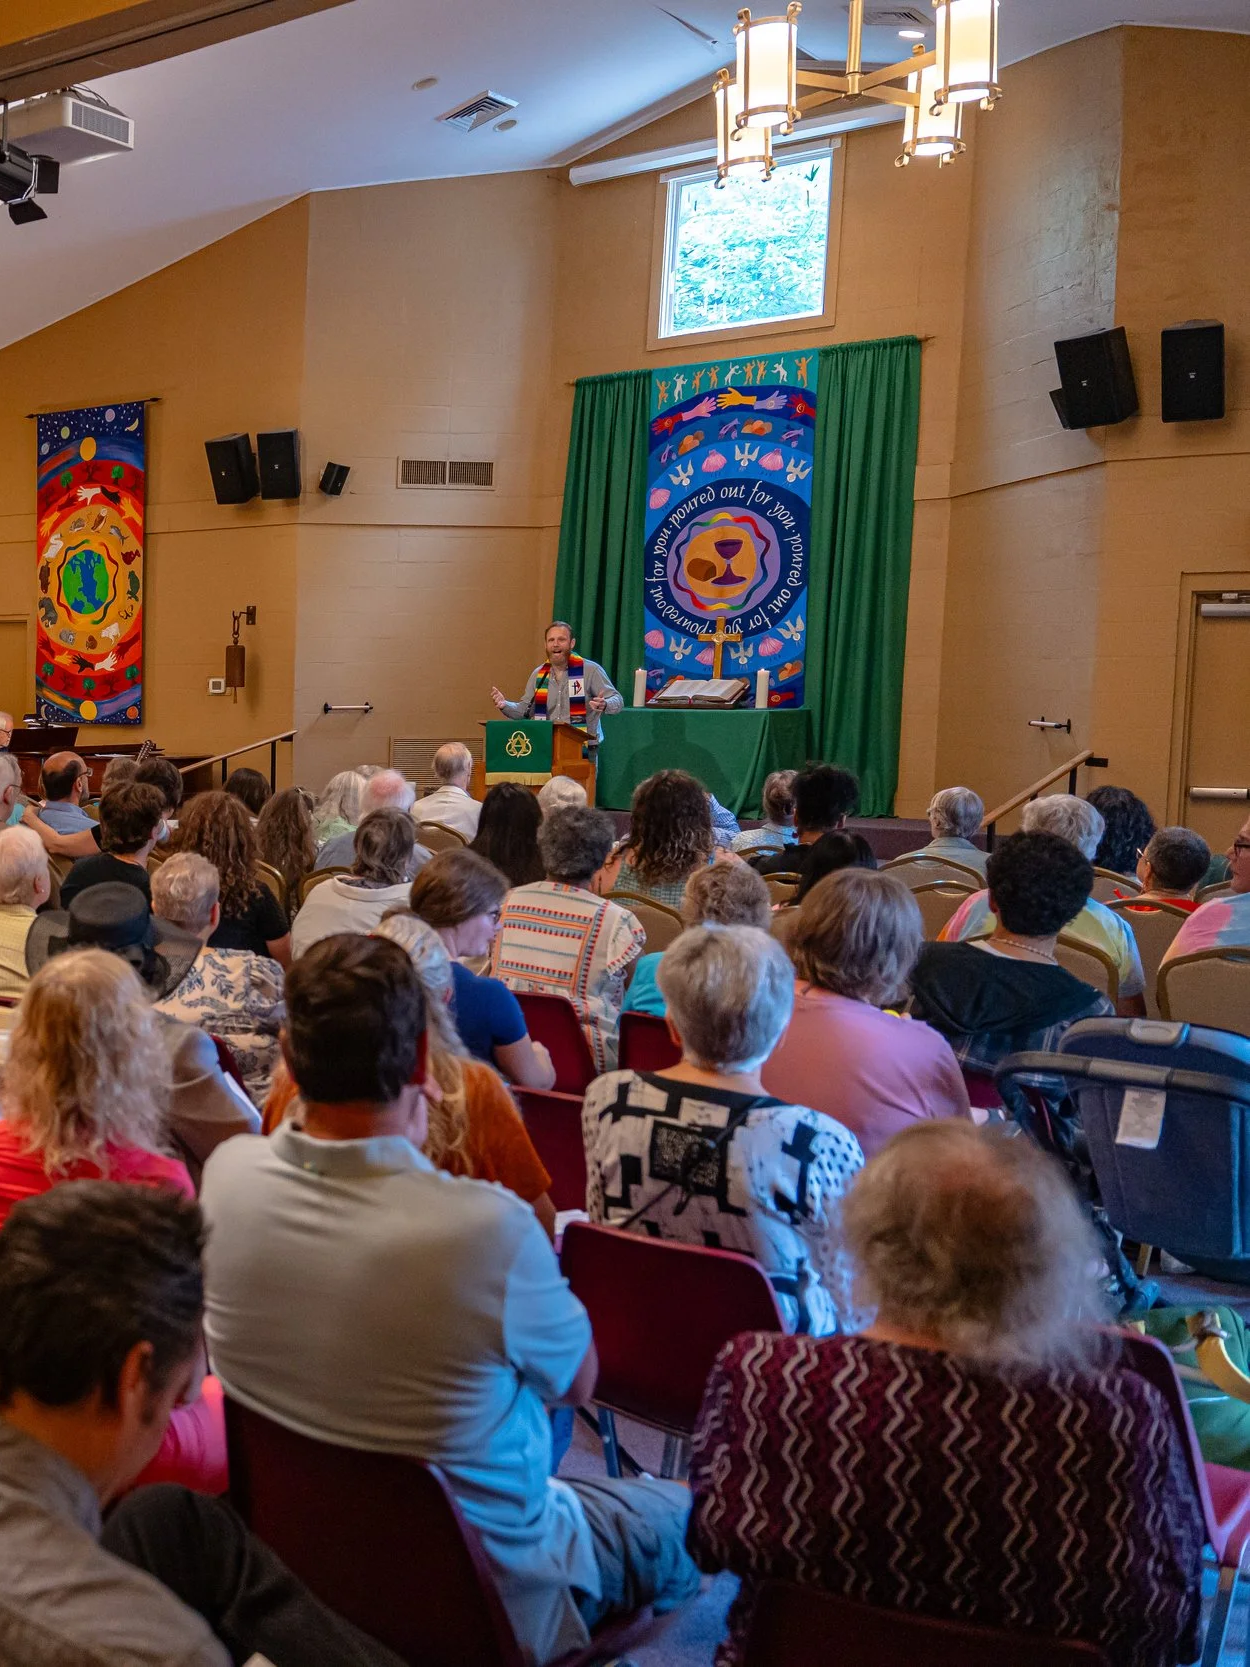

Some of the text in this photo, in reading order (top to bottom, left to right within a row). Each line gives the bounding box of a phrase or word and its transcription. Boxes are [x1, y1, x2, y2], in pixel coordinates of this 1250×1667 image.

[668, 480, 797, 531] poured out for you
[645, 526, 711, 635] poured out for you
[783, 533, 805, 587] poured
[748, 607, 773, 630] for
[768, 588, 792, 614] out
